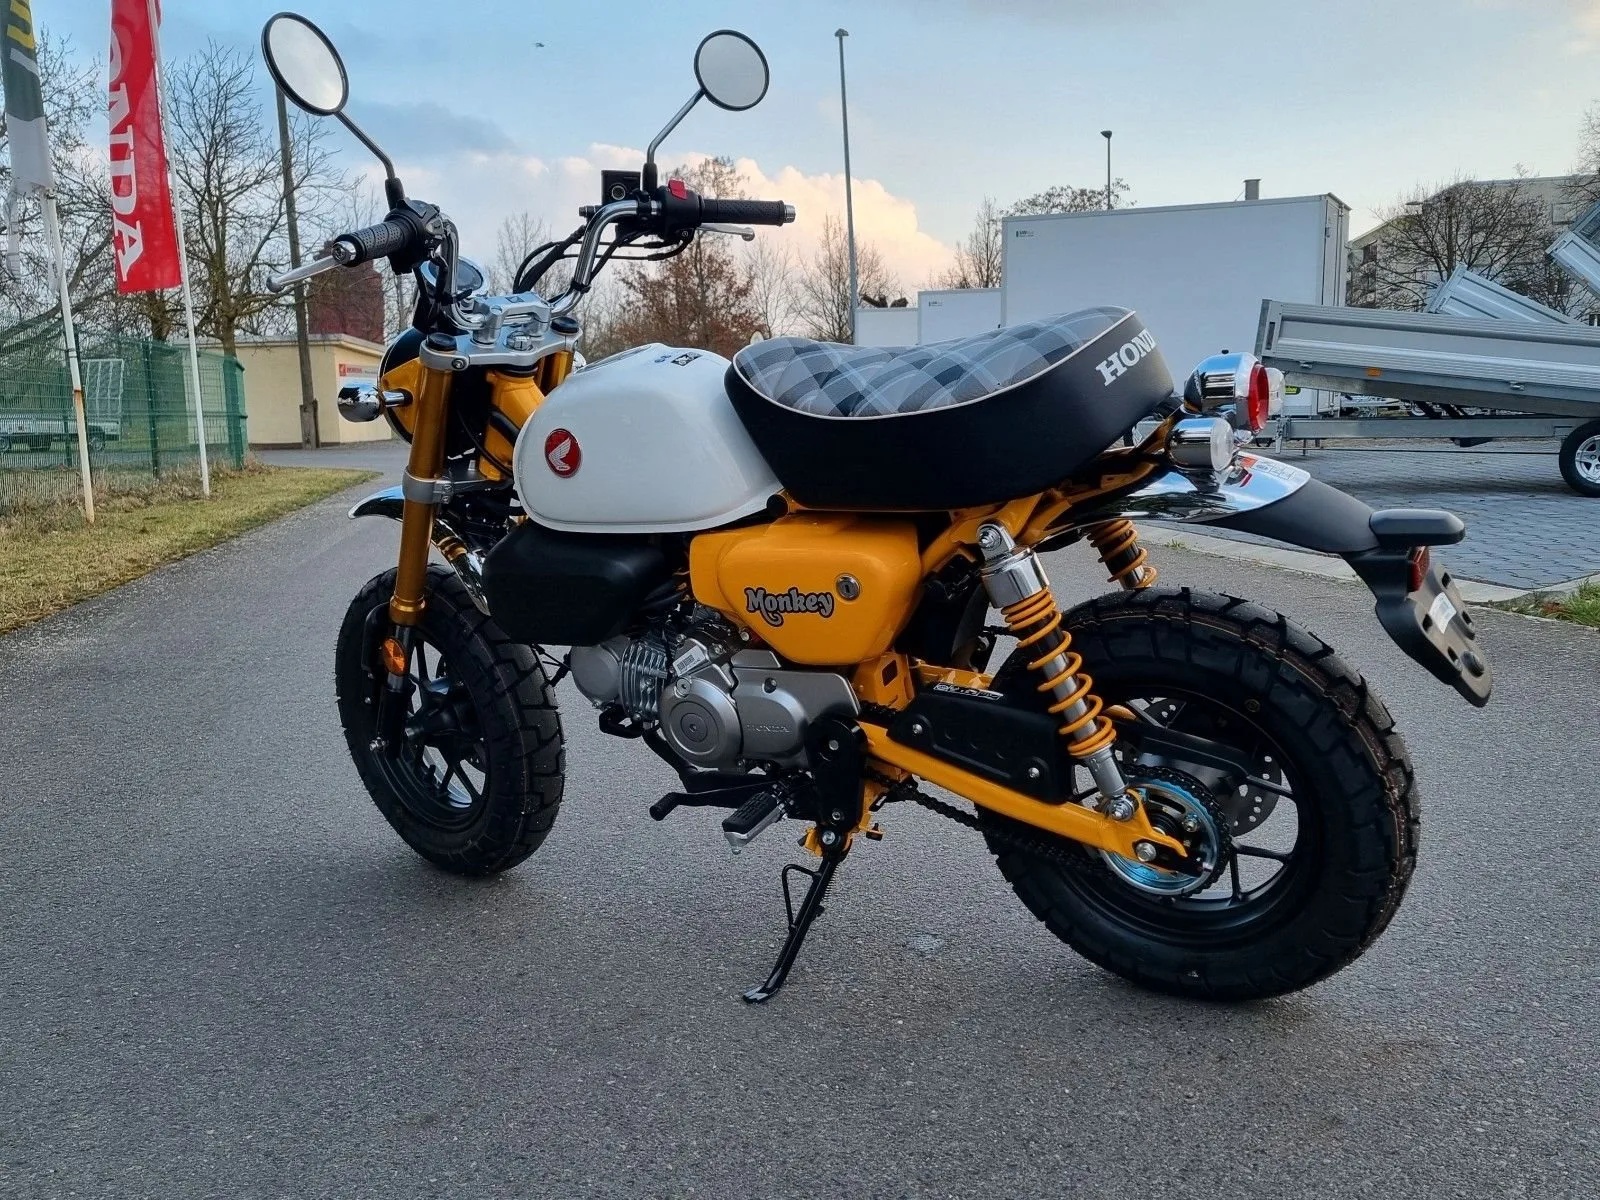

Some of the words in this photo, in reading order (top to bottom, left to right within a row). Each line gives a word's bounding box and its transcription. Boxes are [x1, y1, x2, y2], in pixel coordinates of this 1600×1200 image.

[109, 25, 144, 282] ONDA
[1095, 328, 1157, 387] HOND
[744, 587, 834, 627] Monkey
